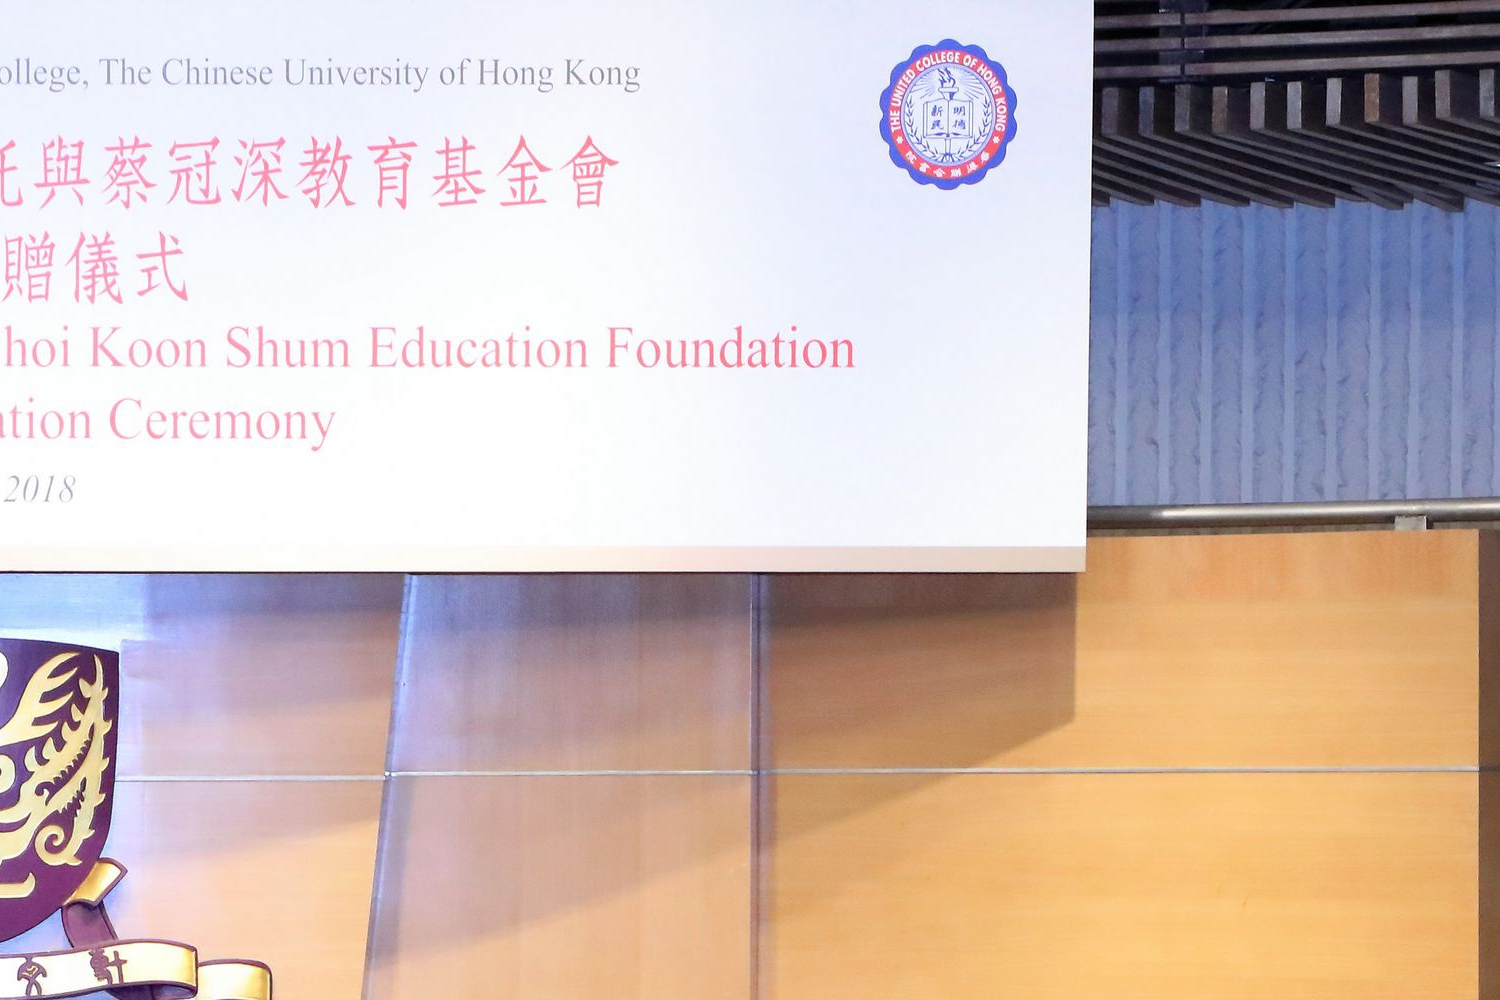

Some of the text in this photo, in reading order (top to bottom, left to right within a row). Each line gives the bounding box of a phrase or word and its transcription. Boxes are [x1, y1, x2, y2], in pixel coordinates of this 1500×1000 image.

[99, 58, 152, 86] The
[162, 57, 274, 87] Chinese
[284, 57, 429, 93] University
[440, 57, 472, 87] of
[478, 58, 555, 93] Hong
[564, 58, 641, 93] Kong
[890, 51, 1008, 133] THE UNITED COLLEGE OF HONG KONG
[90, 326, 208, 369] Koon
[227, 325, 352, 369] Shum
[369, 325, 588, 369] Education
[607, 325, 855, 369] Foundation
[109, 398, 337, 453] Ceremony
